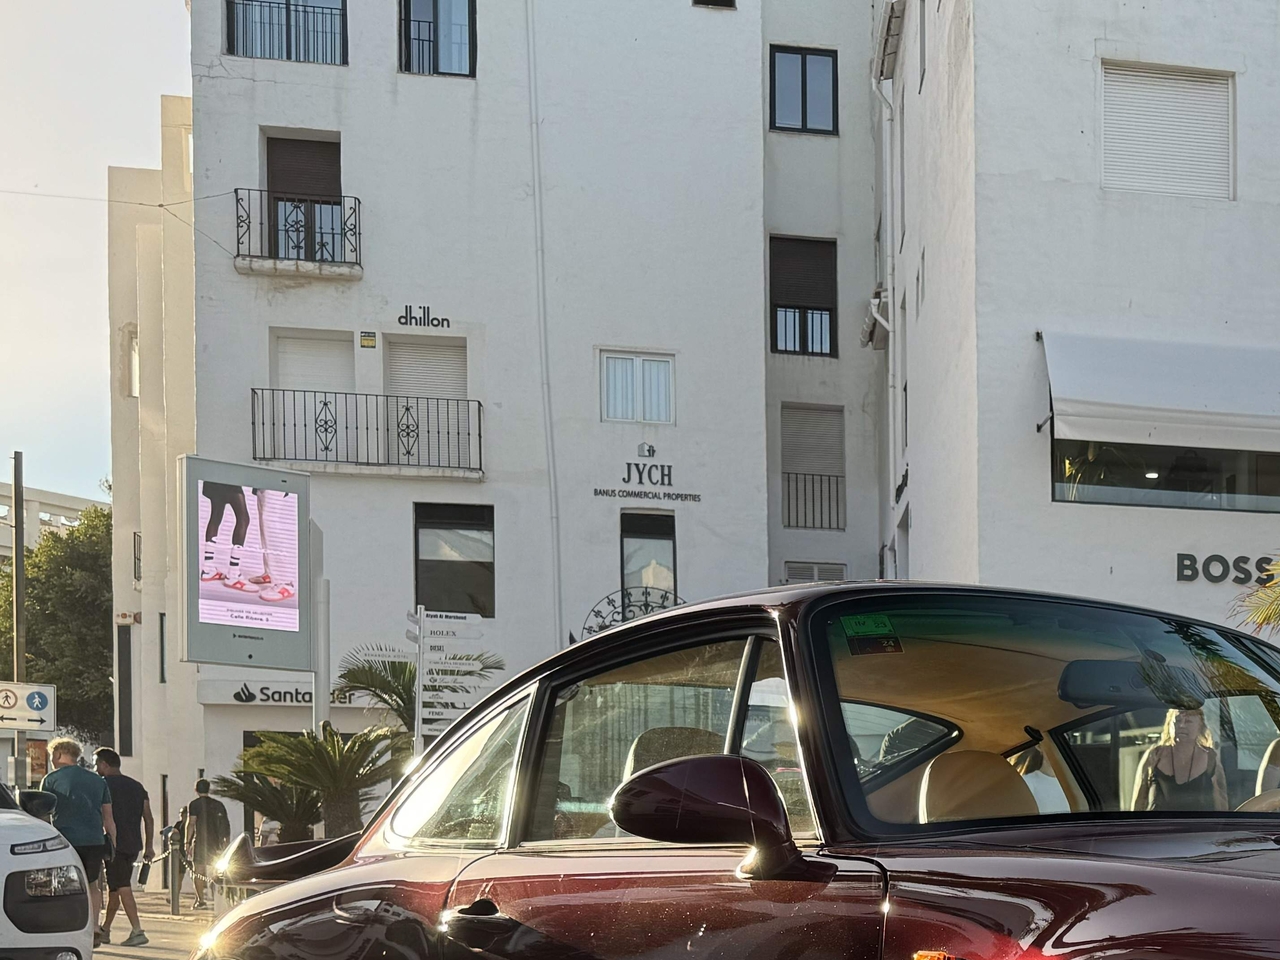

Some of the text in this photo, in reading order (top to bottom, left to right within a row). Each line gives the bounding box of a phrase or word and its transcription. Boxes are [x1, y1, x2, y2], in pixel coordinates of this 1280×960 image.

[398, 304, 450, 328] dhillon
[622, 462, 673, 487] JYCH
[594, 488, 702, 502] BANUS COMMERCIAL PROPERTIES
[1177, 553, 1275, 586] BOSS
[430, 629, 457, 637] ROLEX
[260, 687, 355, 704] Santader
